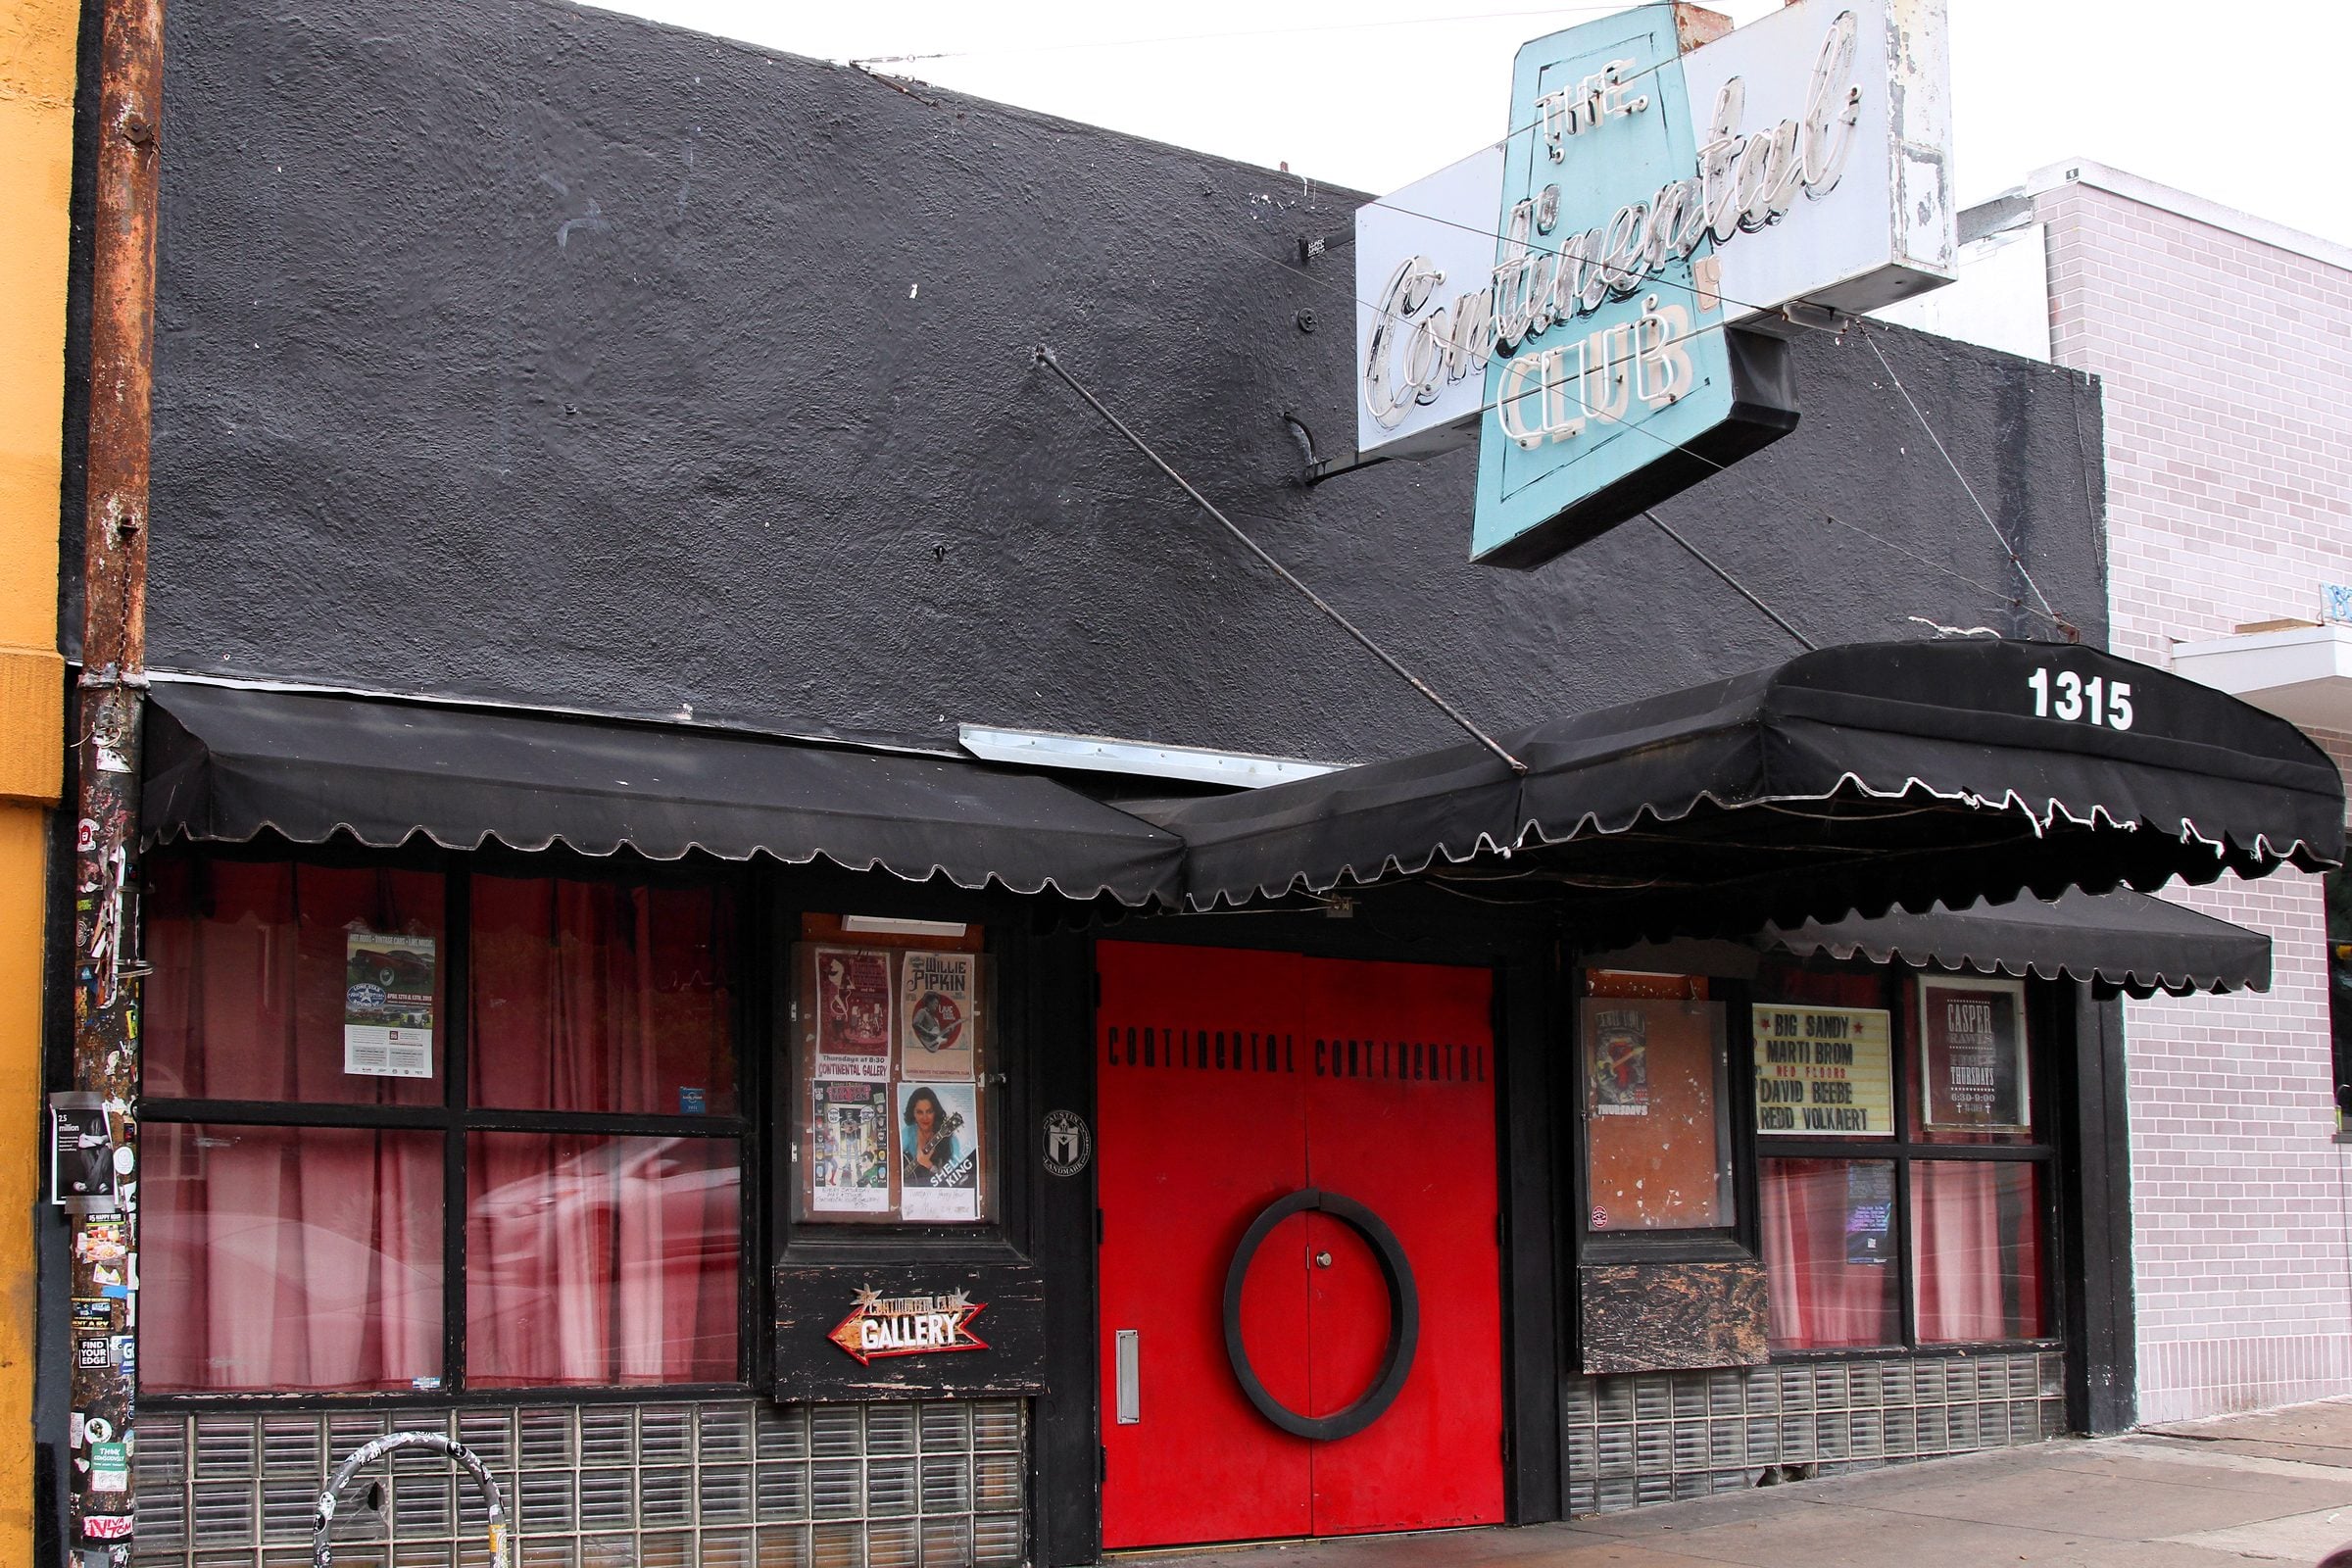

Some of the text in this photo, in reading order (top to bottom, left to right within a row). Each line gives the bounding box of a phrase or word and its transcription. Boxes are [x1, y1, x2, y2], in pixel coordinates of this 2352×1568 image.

[1534, 57, 1649, 164] THE
[1363, 10, 1862, 428] Continental
[1497, 300, 1695, 450] CLUB
[2029, 667, 2132, 731] 1315
[925, 957, 966, 973] WILLIE
[906, 969, 965, 992] PIPKIN
[1775, 1014, 1849, 1039] BIG SANDY
[1948, 1004, 1992, 1033] CASPER
[1109, 1027, 1295, 1072] CONTINENTAL
[1316, 1040, 1484, 1081] CONTINENTAL
[1767, 1040, 1853, 1065] MARTI BROM
[818, 1063, 887, 1077] CONTINENTAL GALLERY
[1950, 1066, 1994, 1086] THURSDAYS
[1760, 1078, 1852, 1104] DAVID BEEBE
[1049, 1111, 1079, 1123] AUSTIN
[1760, 1106, 1868, 1131] REDD VOLKAERT
[930, 1141, 974, 1187] SHELLEY
[946, 1158, 973, 1187] KING
[1044, 1158, 1084, 1175] LANDMARK
[861, 1313, 959, 1349] GALLERY
[81, 1348, 106, 1357] YOUR
